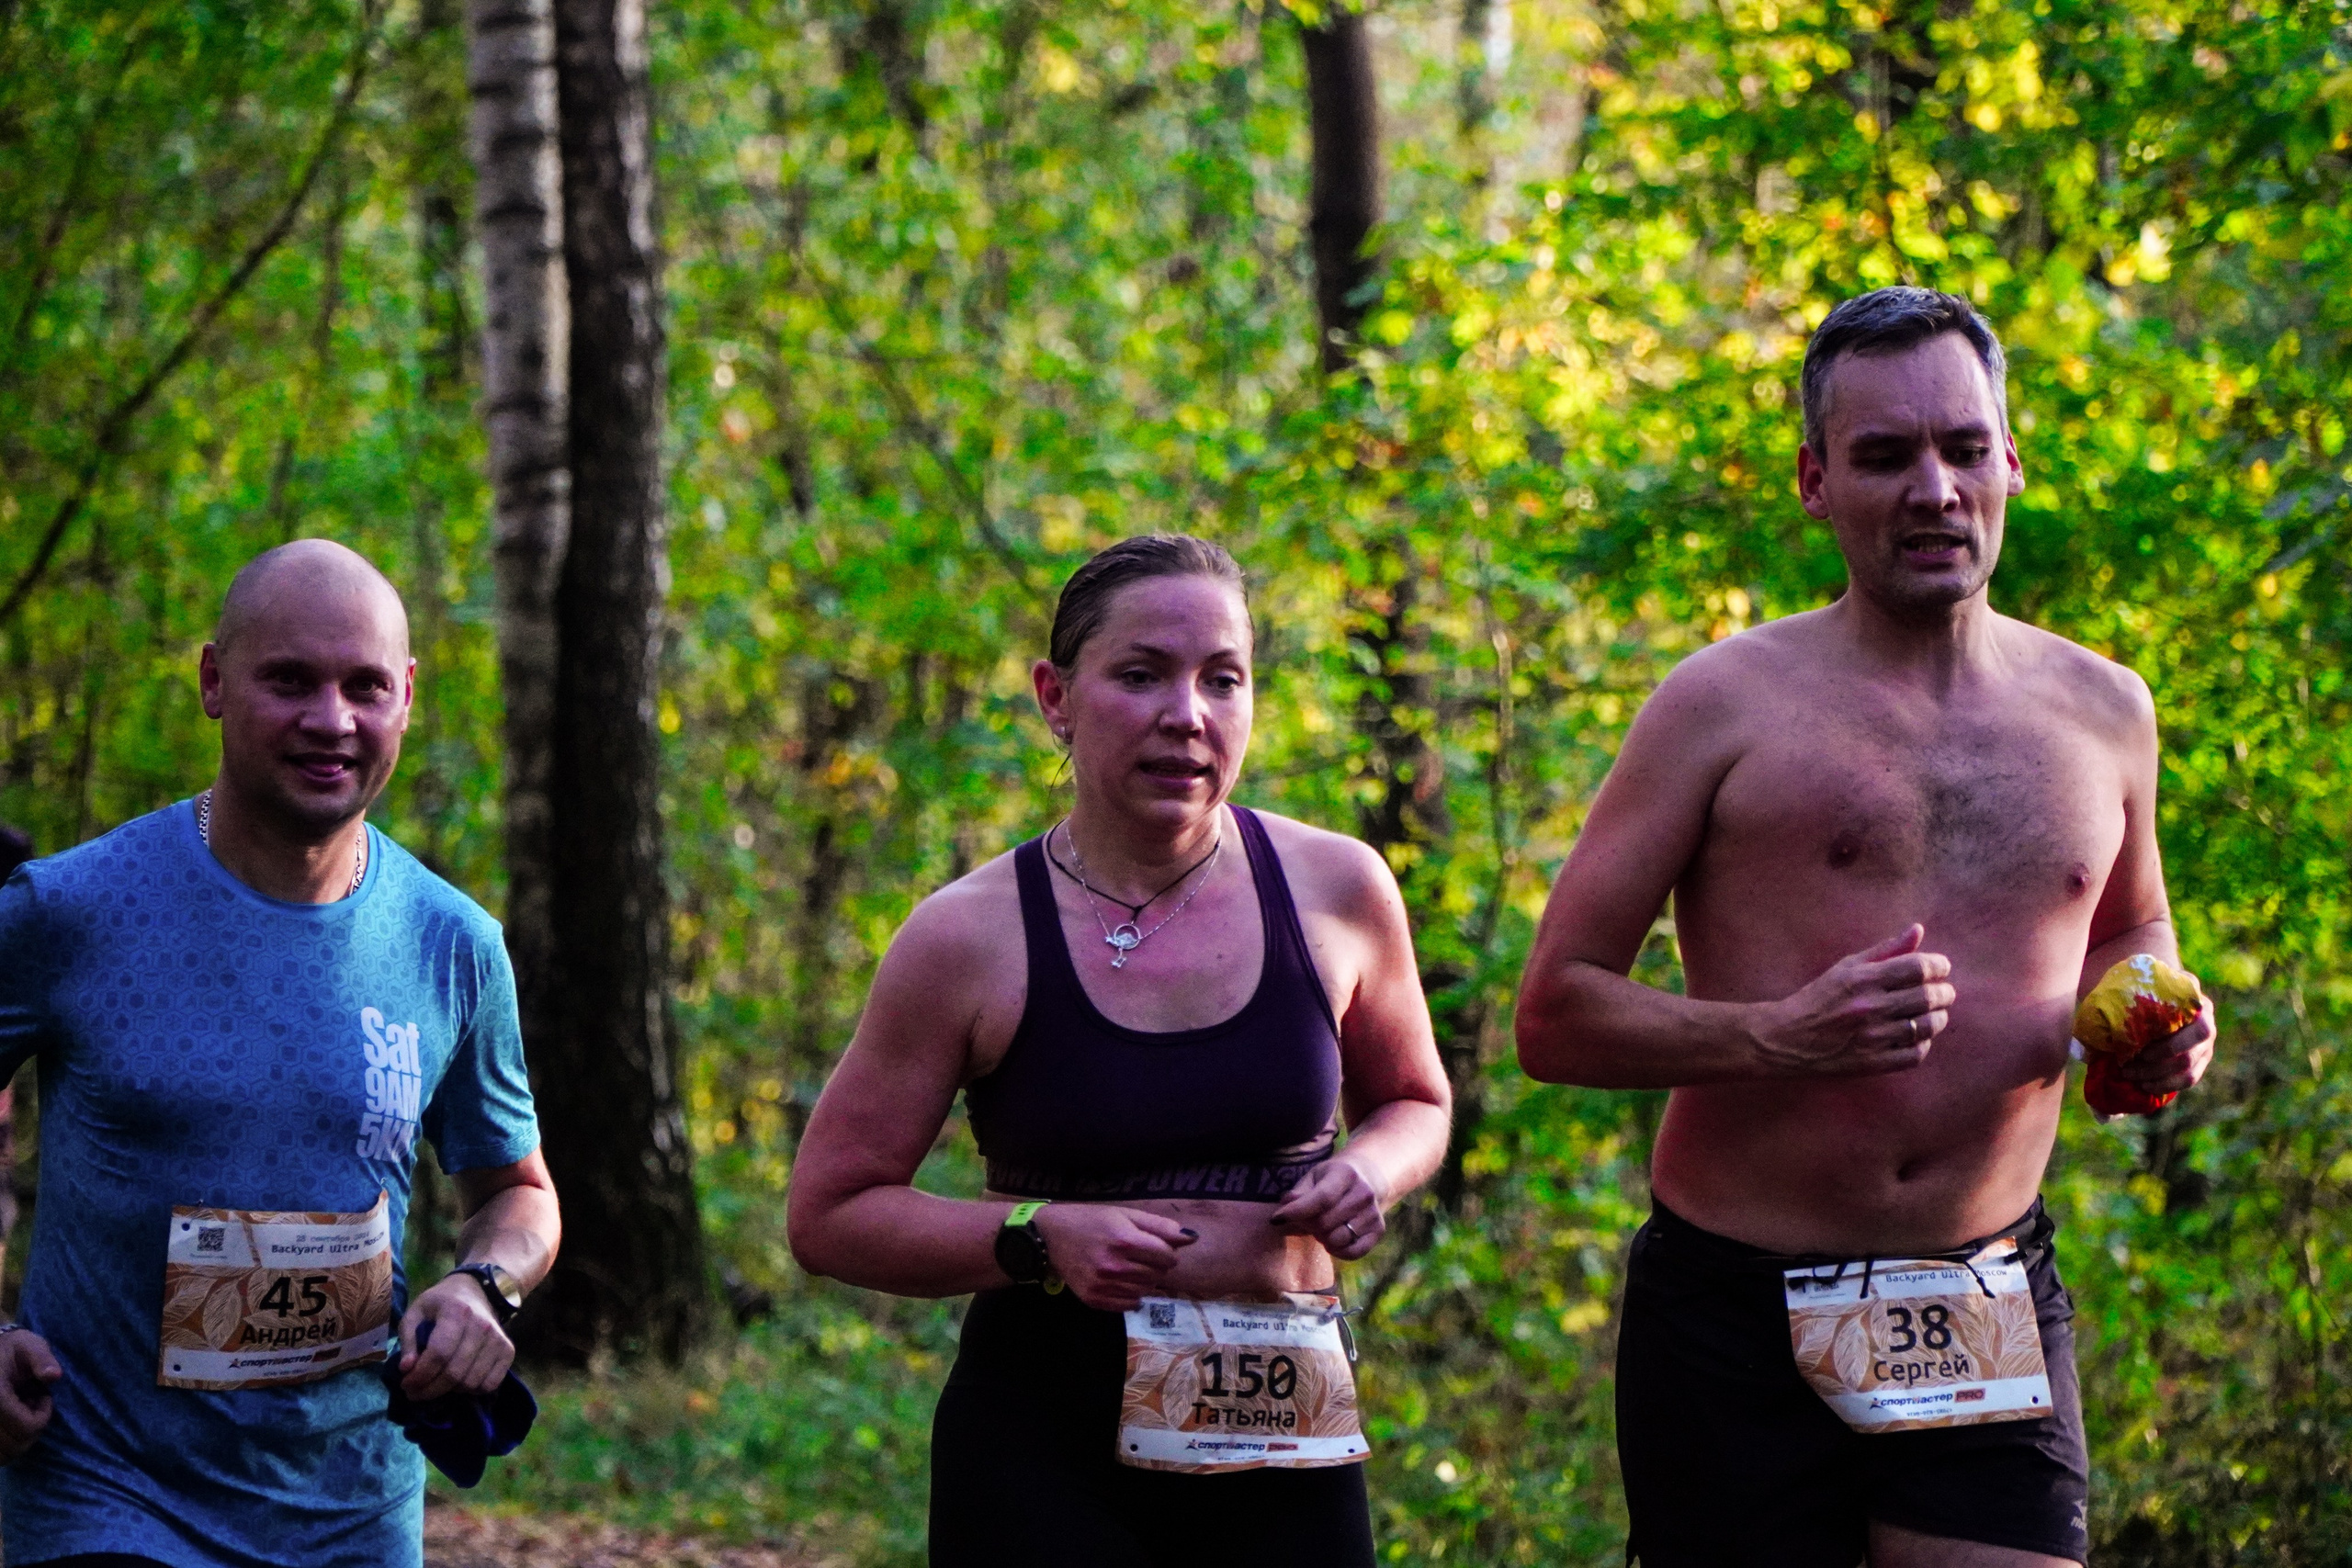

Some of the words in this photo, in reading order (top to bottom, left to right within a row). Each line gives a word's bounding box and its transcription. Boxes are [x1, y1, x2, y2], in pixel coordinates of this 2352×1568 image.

[360, 1006, 422, 1077] Sat
[365, 1066, 422, 1122] 9AM
[1122, 1163, 1250, 1194] POWER
[271, 1244, 323, 1255] Backyard
[330, 1243, 359, 1254] Ultra
[1885, 1271, 1936, 1283] Backyard
[1940, 1269, 1971, 1279] Ultra
[259, 1276, 329, 1317] 45
[240, 1316, 336, 1348] Андрей
[1223, 1318, 1269, 1331] Backyard
[1885, 1303, 1952, 1353] 38
[1201, 1352, 1297, 1401] 150
[1873, 1353, 1970, 1385] Сергей
[1955, 1389, 1984, 1401] PRO
[1191, 1402, 1296, 1429] Татьяна
